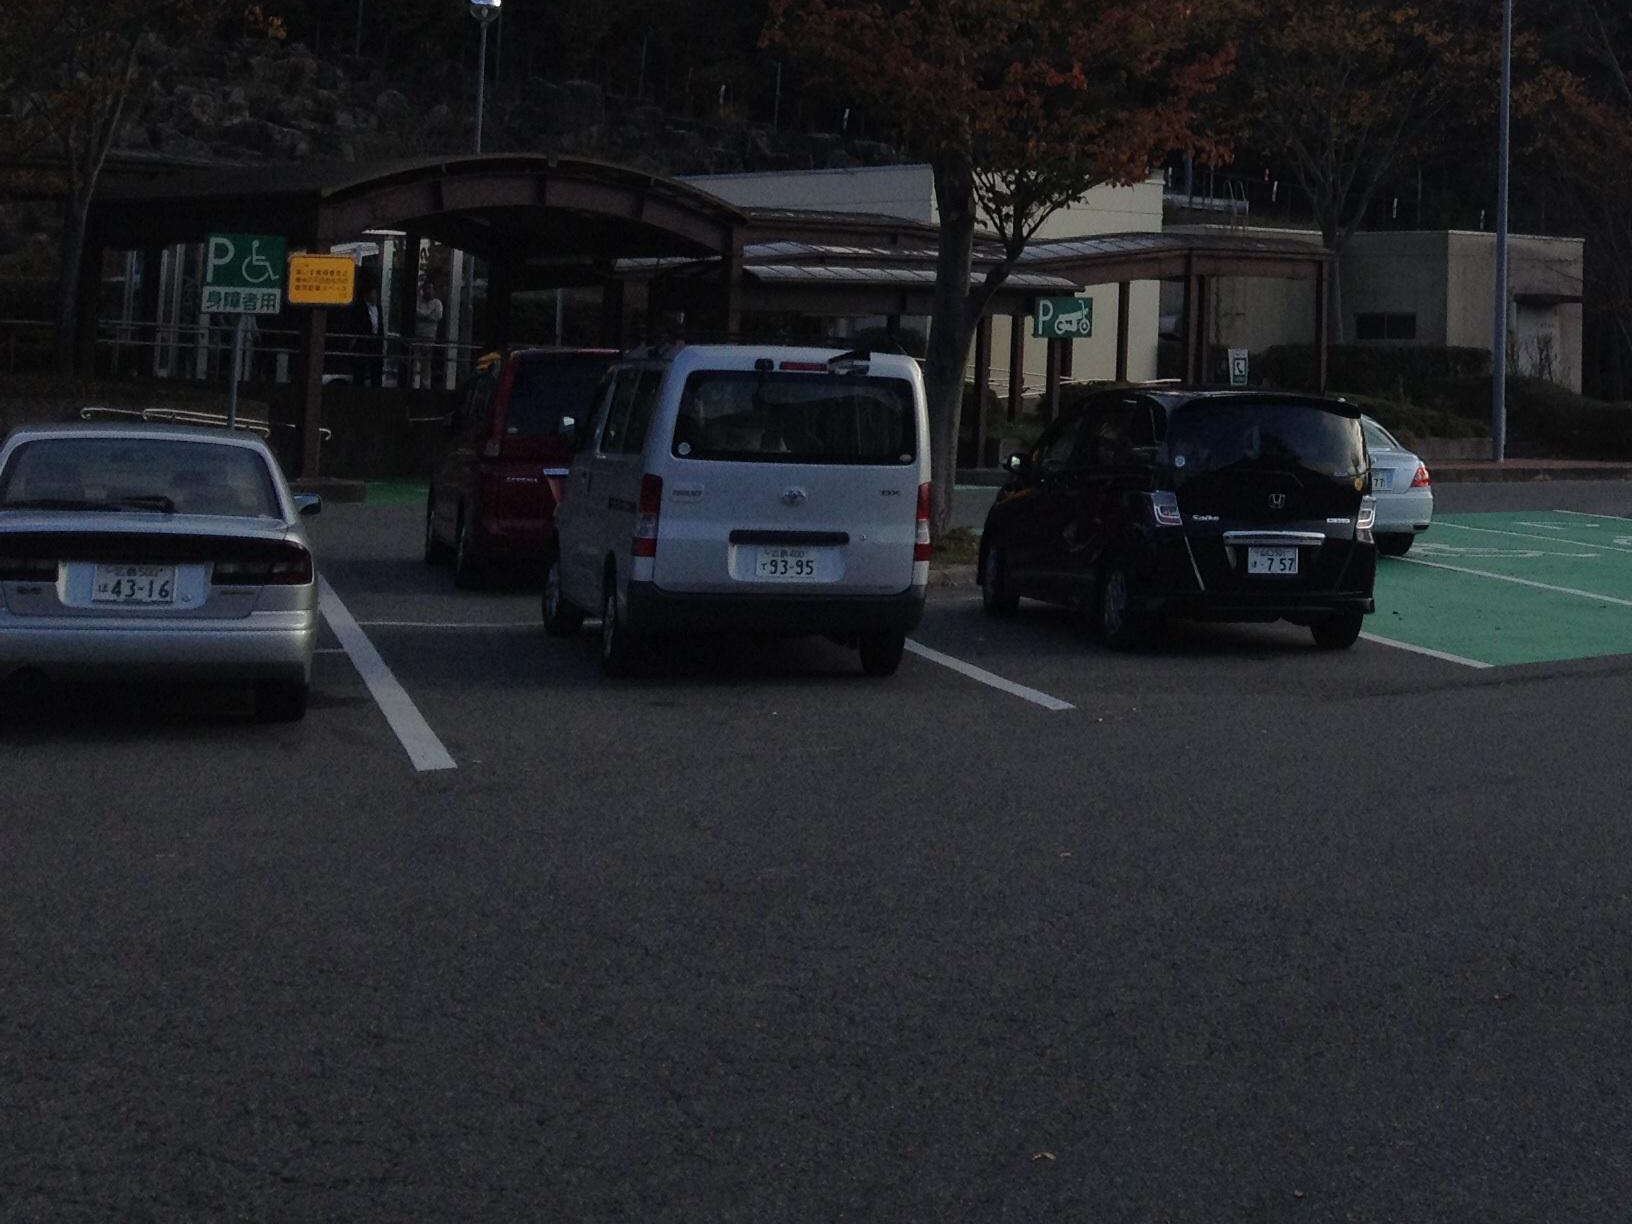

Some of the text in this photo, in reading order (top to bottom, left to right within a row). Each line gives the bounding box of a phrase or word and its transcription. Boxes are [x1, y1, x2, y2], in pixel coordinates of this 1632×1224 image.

[206, 237, 235, 283] P
[206, 290, 277, 311] 身障者用
[1038, 299, 1054, 335] P
[770, 559, 814, 575] 93-95
[111, 579, 170, 598] 43-16
